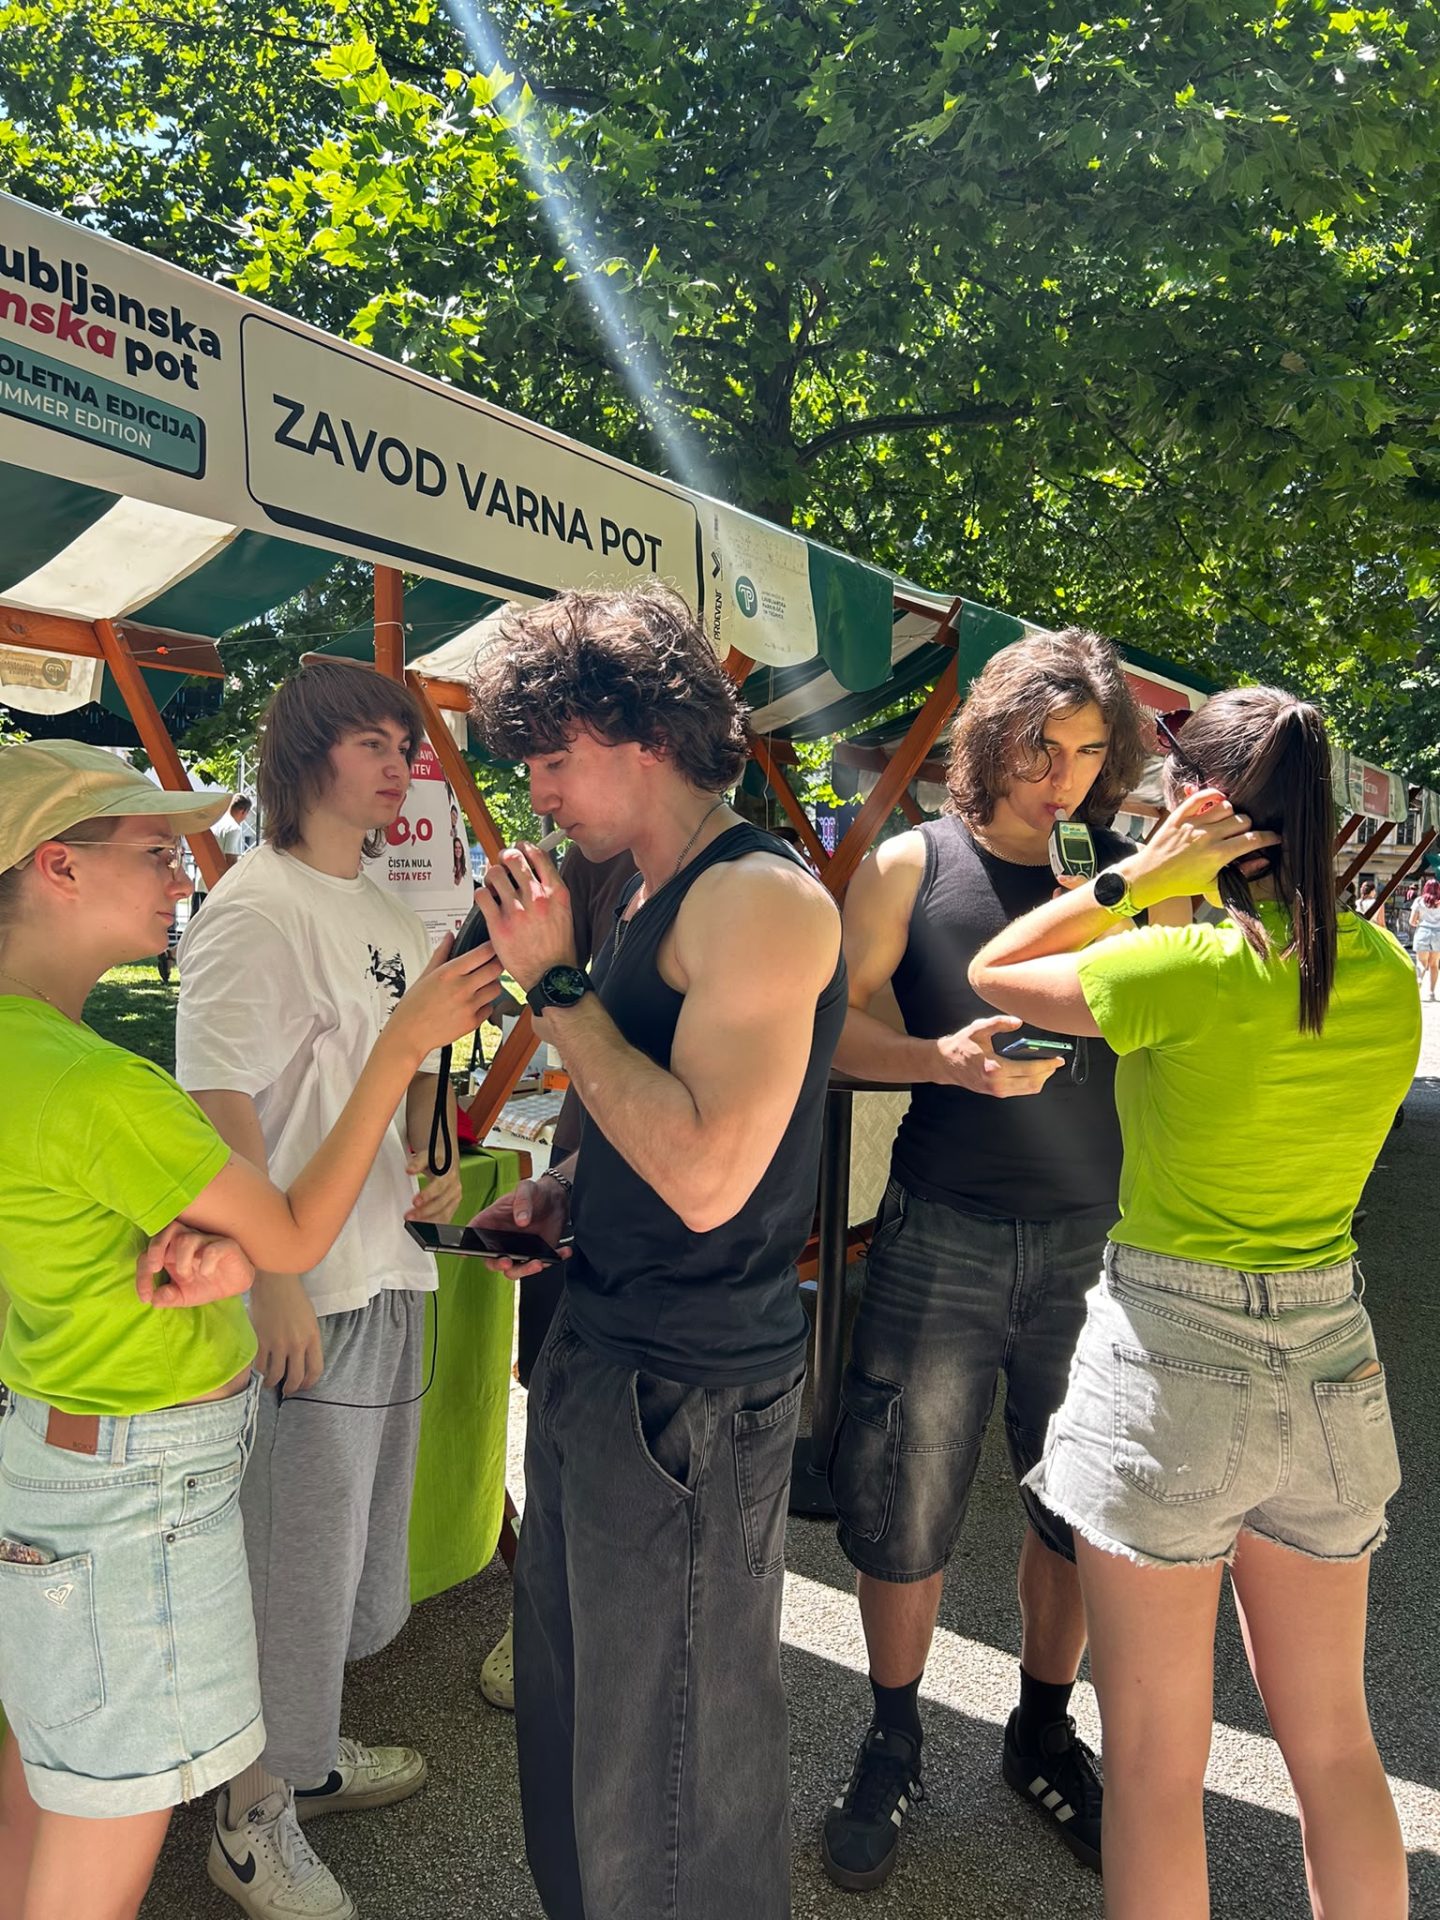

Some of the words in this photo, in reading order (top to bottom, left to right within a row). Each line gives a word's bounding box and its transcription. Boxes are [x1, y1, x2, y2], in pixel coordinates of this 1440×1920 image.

[125, 336, 199, 390] pot
[0, 353, 99, 408] OLETNA
[106, 394, 196, 443] EDICIJA
[0, 380, 69, 420] MMER
[75, 408, 152, 449] EDITION
[273, 393, 447, 497] ZAVOD
[457, 463, 593, 551] VARNA
[601, 517, 663, 572] POT
[388, 856, 410, 868] ČISTA
[412, 859, 432, 868] NULA
[388, 870, 410, 881] ČISTA
[411, 872, 431, 881] VEST
